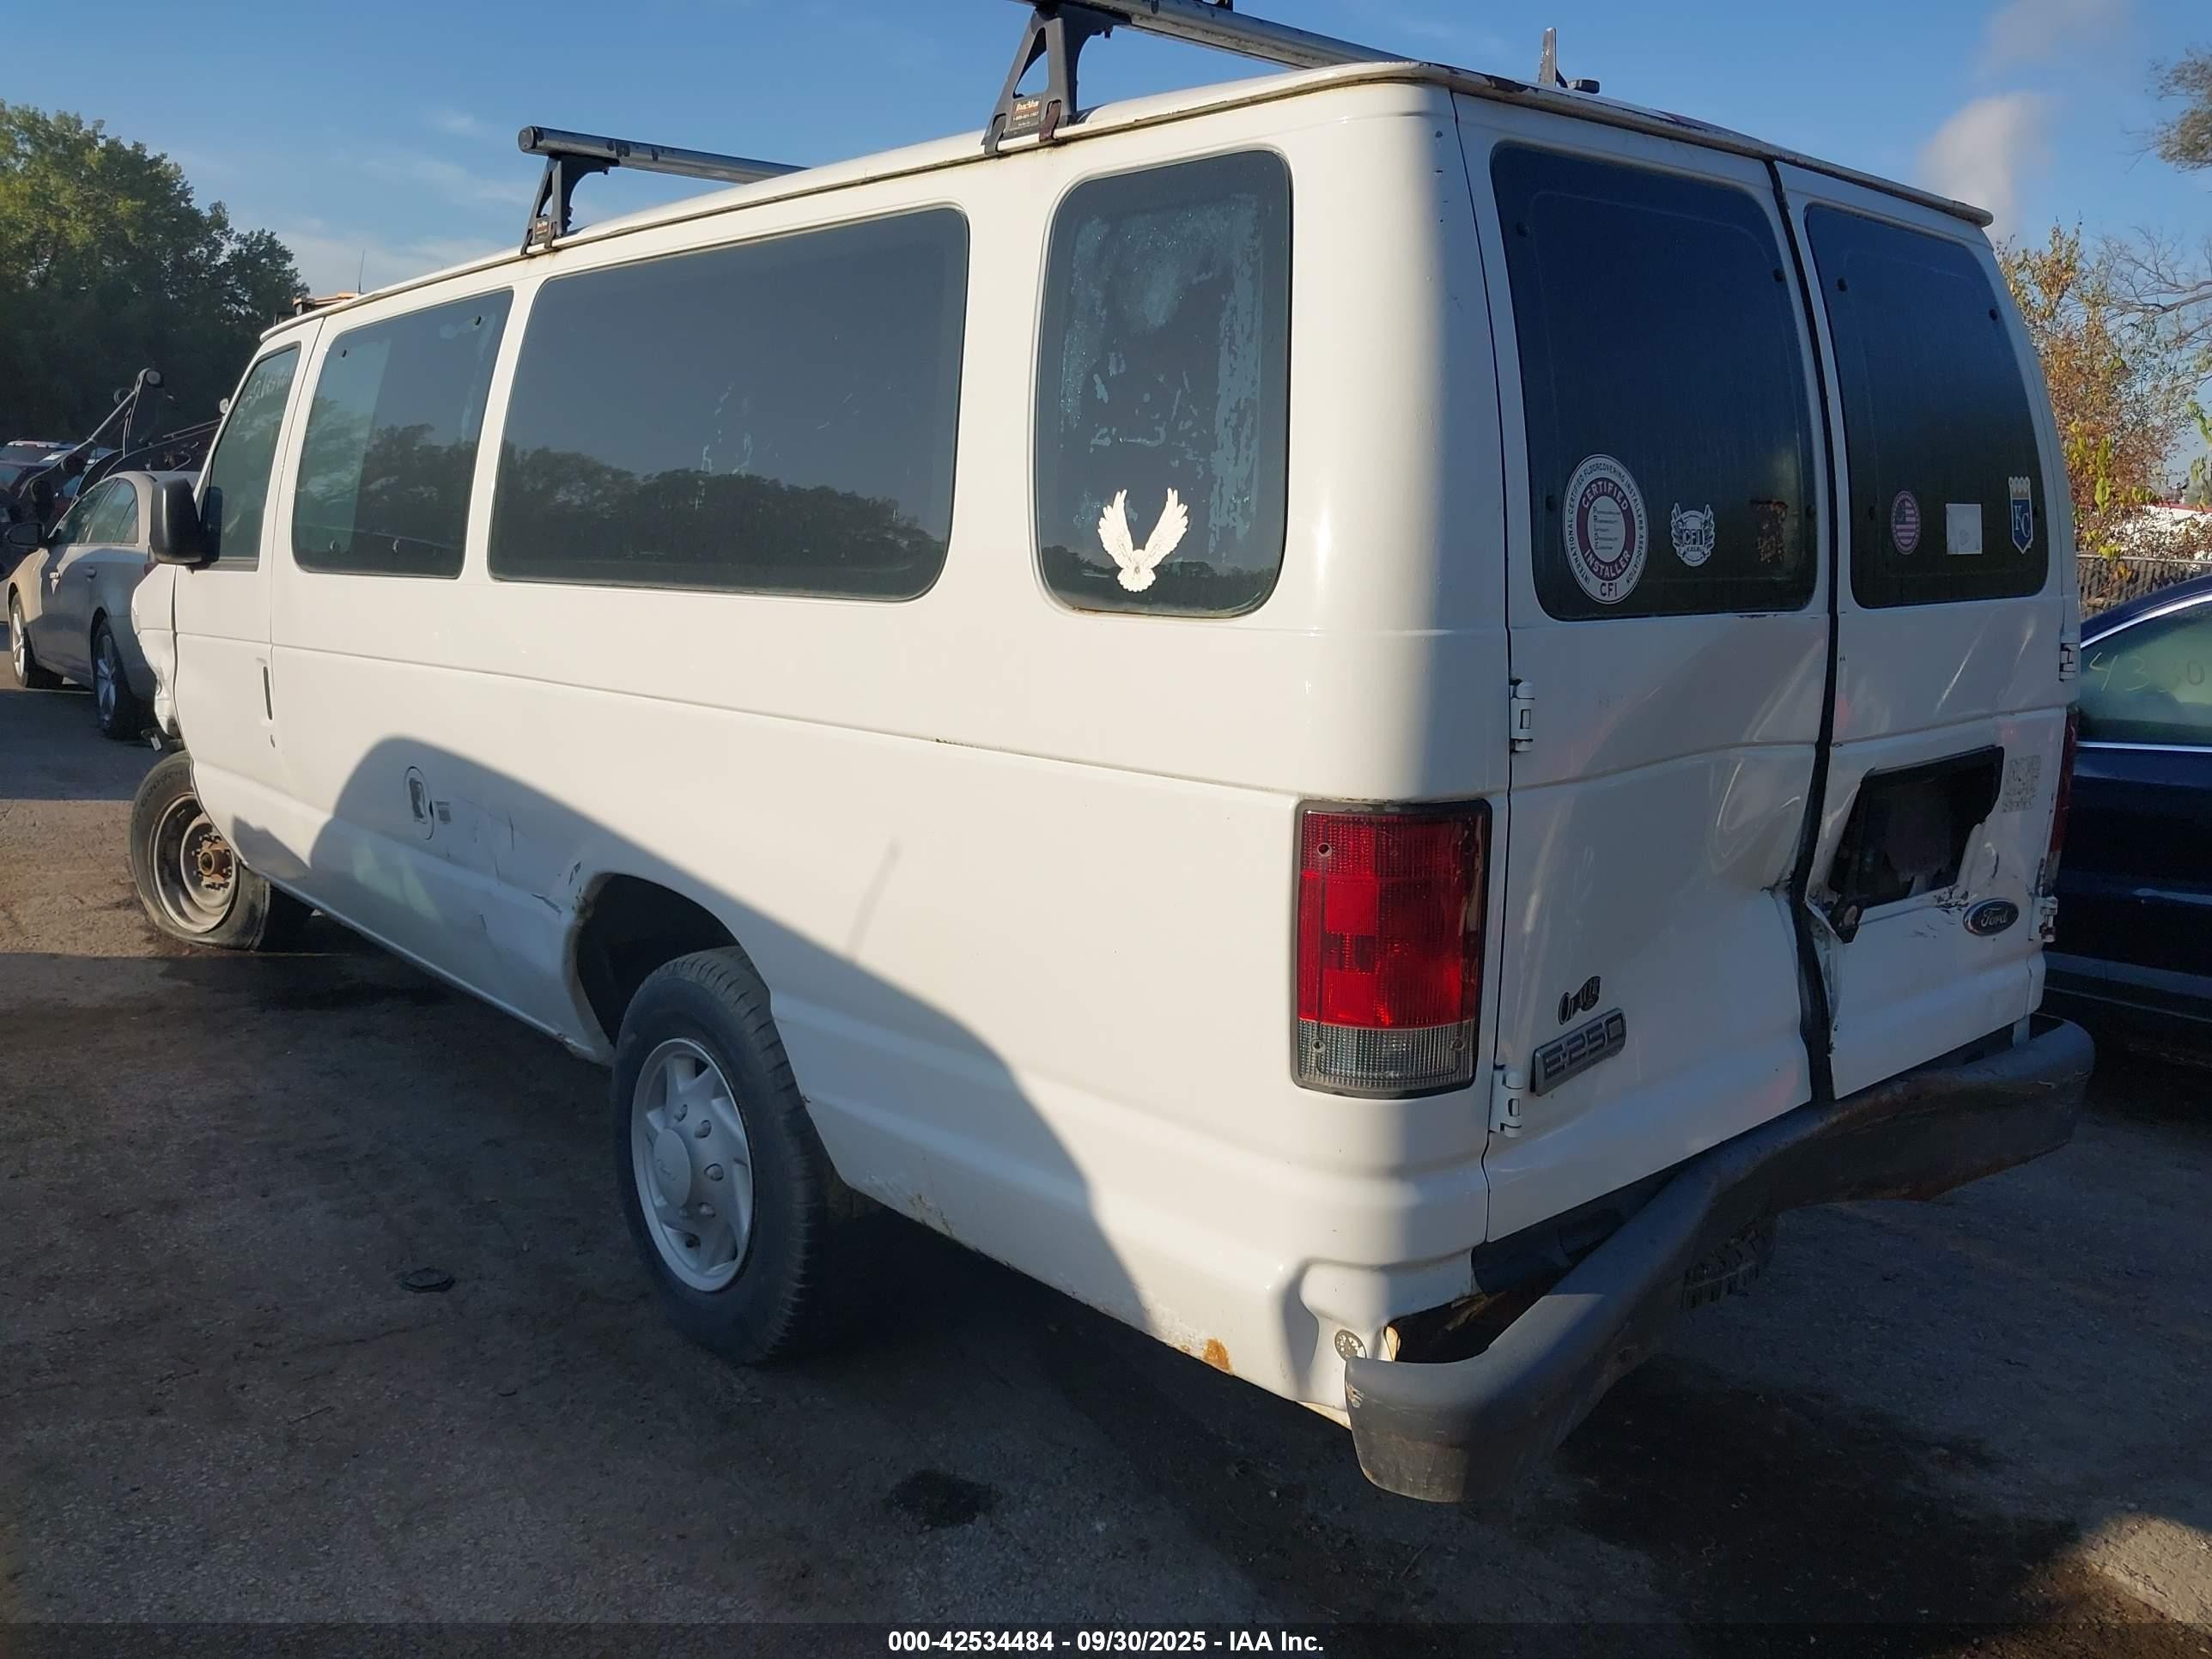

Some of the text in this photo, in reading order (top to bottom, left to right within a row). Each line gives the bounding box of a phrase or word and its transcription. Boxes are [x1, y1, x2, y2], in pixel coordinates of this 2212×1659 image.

[1582, 480, 1629, 510] CERTIFIED
[2014, 505, 2031, 538] KC
[1683, 528, 1704, 545] CFI
[1583, 549, 1632, 578] INSTALLER
[1600, 582, 1618, 598] CFI
[1980, 907, 2008, 927] Ford
